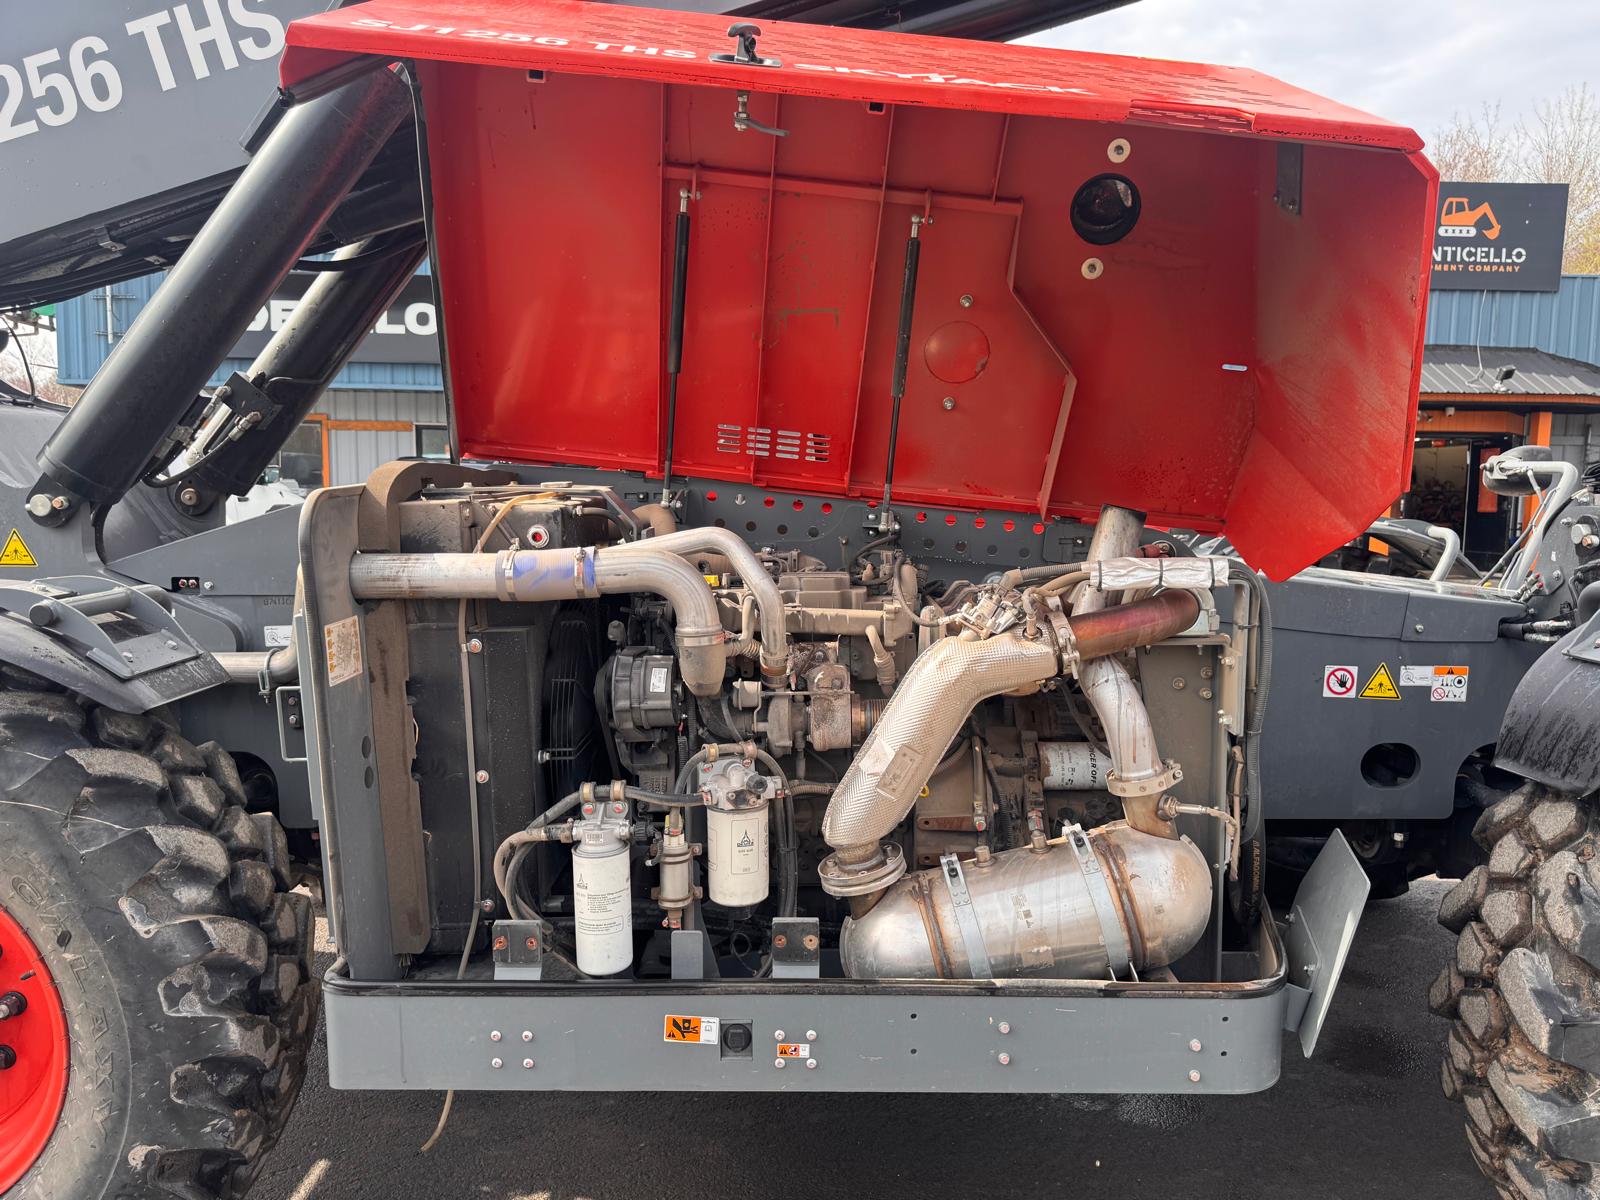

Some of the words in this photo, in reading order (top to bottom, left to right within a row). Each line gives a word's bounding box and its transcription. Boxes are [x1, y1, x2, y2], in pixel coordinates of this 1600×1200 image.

[125, 0, 285, 92] THS
[351, 18, 570, 46] SJ1256
[589, 41, 697, 59] THS
[1431, 264, 1464, 272] MENT
[1468, 264, 1520, 273] COMPANY
